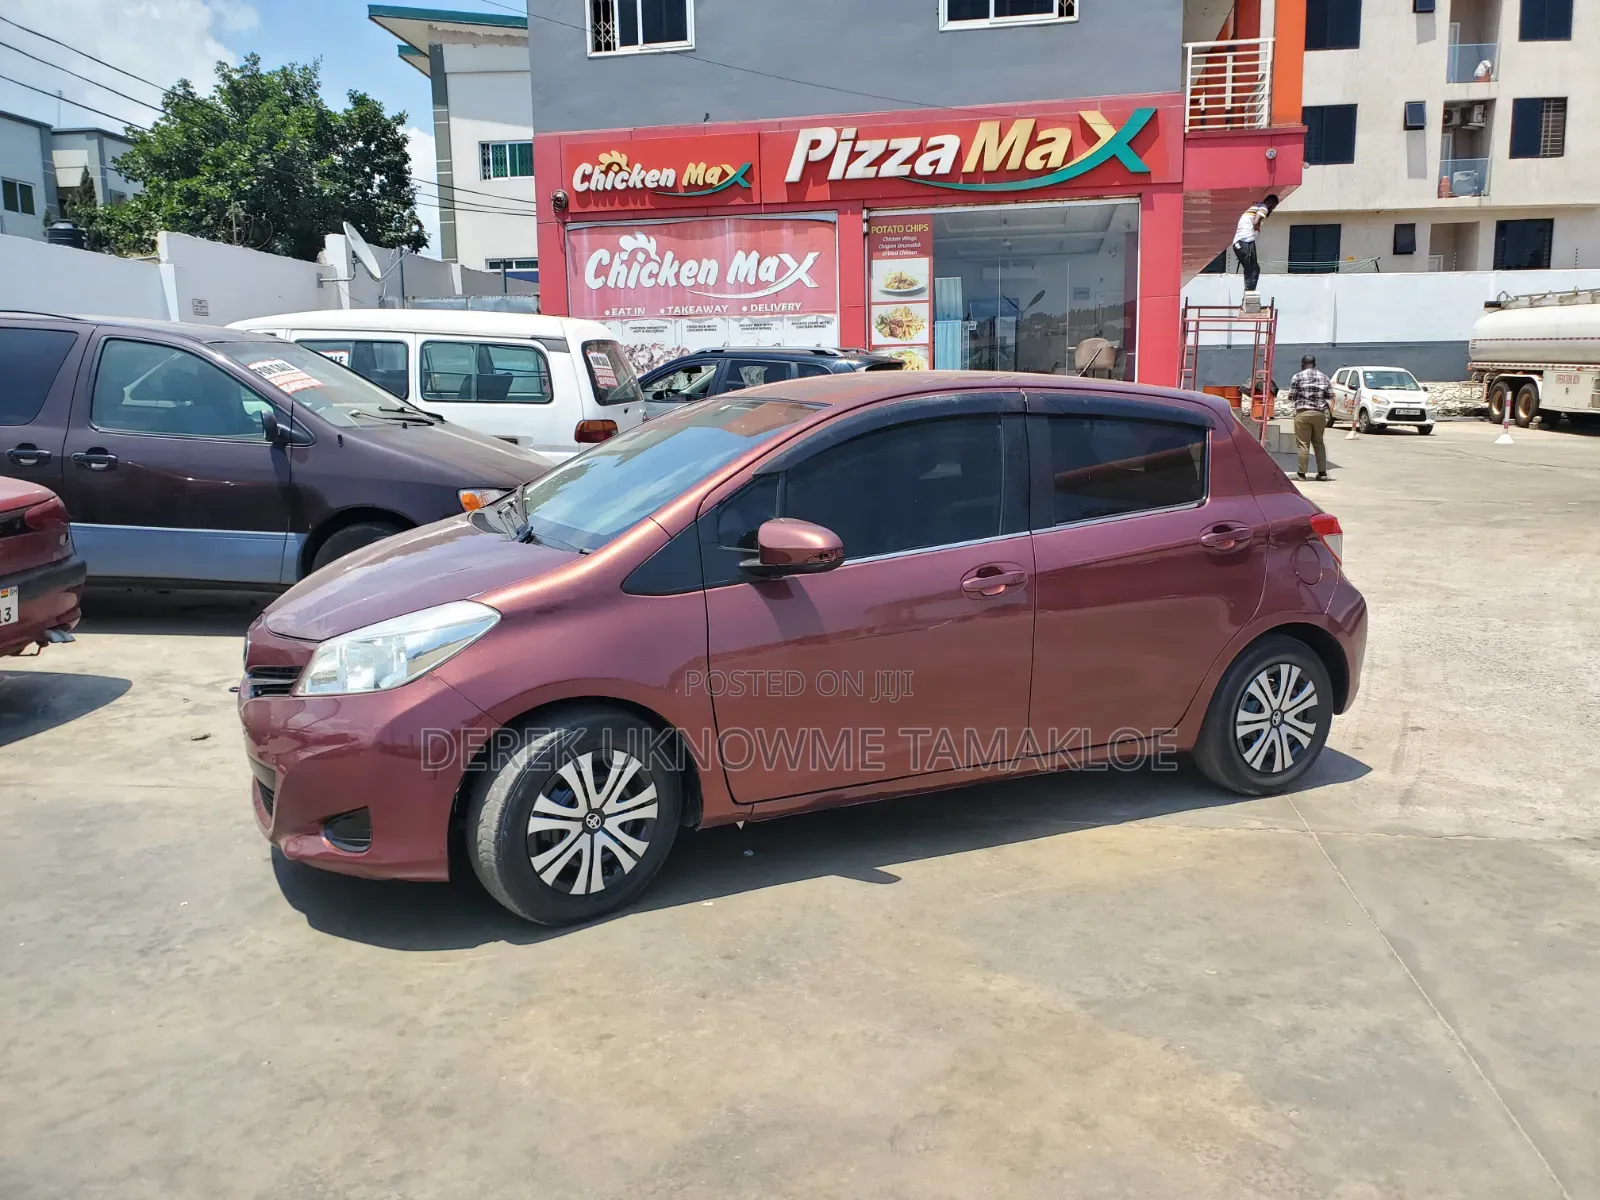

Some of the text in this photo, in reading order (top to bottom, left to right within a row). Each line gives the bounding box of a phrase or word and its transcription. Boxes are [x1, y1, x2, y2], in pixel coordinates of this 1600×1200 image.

[784, 126, 960, 183] Pizza
[572, 161, 677, 192] Chicken
[871, 224, 929, 234] POTATO CHIPS
[584, 248, 719, 290] Chicken
[611, 307, 646, 316] EAT IN
[667, 305, 729, 315] TAKEAWAY
[750, 302, 803, 312] DELIVERY
